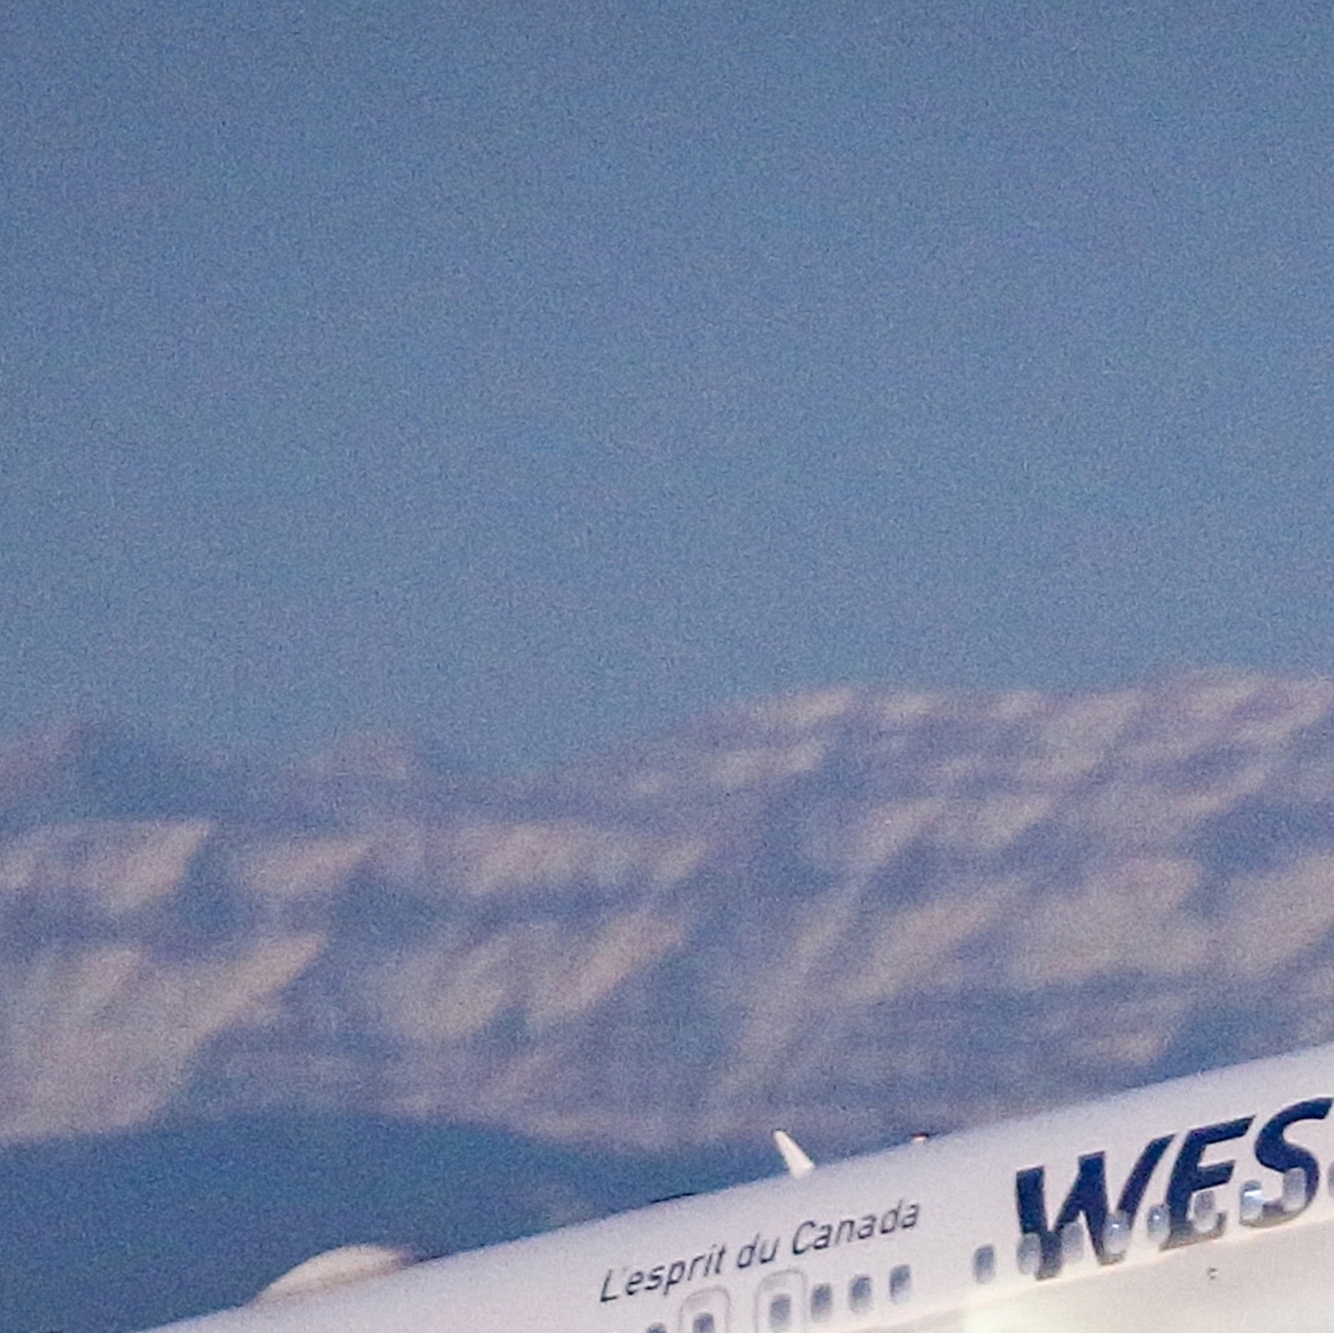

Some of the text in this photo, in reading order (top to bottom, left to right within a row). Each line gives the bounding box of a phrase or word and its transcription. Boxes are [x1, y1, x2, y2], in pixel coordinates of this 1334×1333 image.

[599, 1200, 921, 1303] L'esprit du Canada
